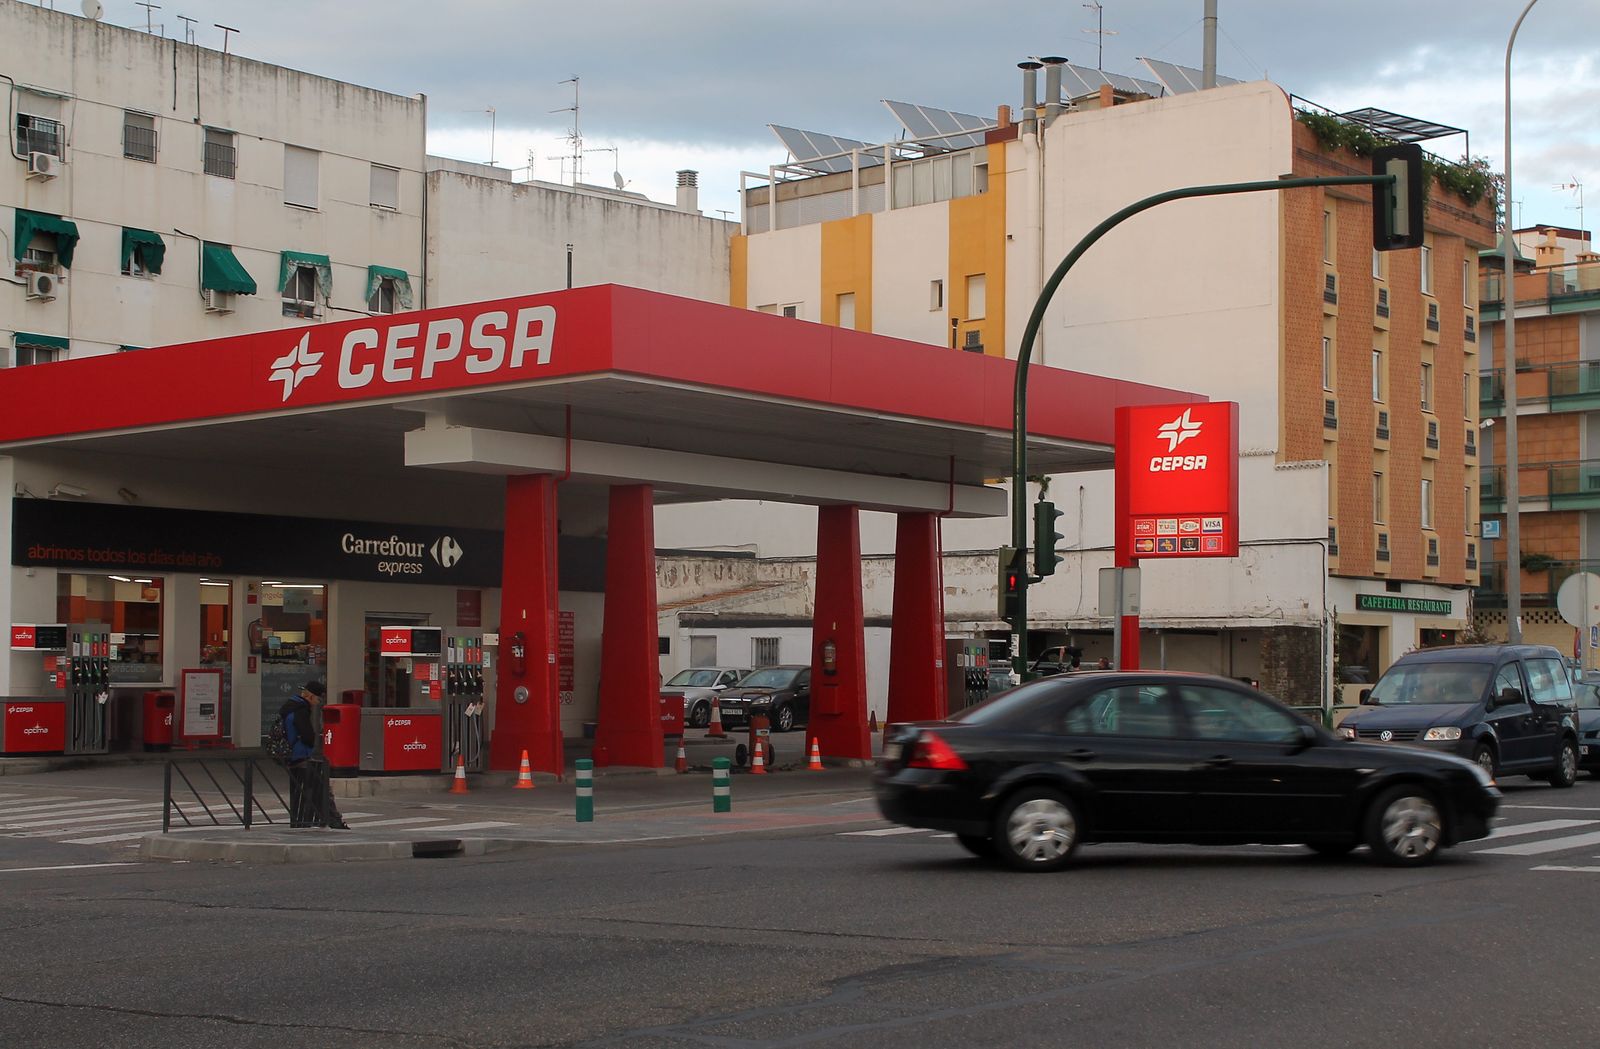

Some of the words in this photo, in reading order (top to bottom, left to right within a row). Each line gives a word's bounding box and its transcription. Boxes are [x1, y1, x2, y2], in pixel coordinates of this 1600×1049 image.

[337, 305, 556, 389] CEPSA
[1150, 455, 1207, 471] CEPSA
[342, 533, 425, 557] Carrefour
[27, 544, 84, 560] abrimos
[87, 547, 125, 563] todos
[127, 548, 145, 563] los
[147, 548, 175, 565] días
[176, 551, 196, 566] del
[198, 552, 222, 568] año
[378, 561, 423, 576] express
[1361, 596, 1406, 609] CAFETERIA
[1407, 599, 1451, 612] RESTAURANTE
[386, 635, 407, 645] optima
[23, 725, 48, 735] optima
[403, 740, 427, 751] optima
